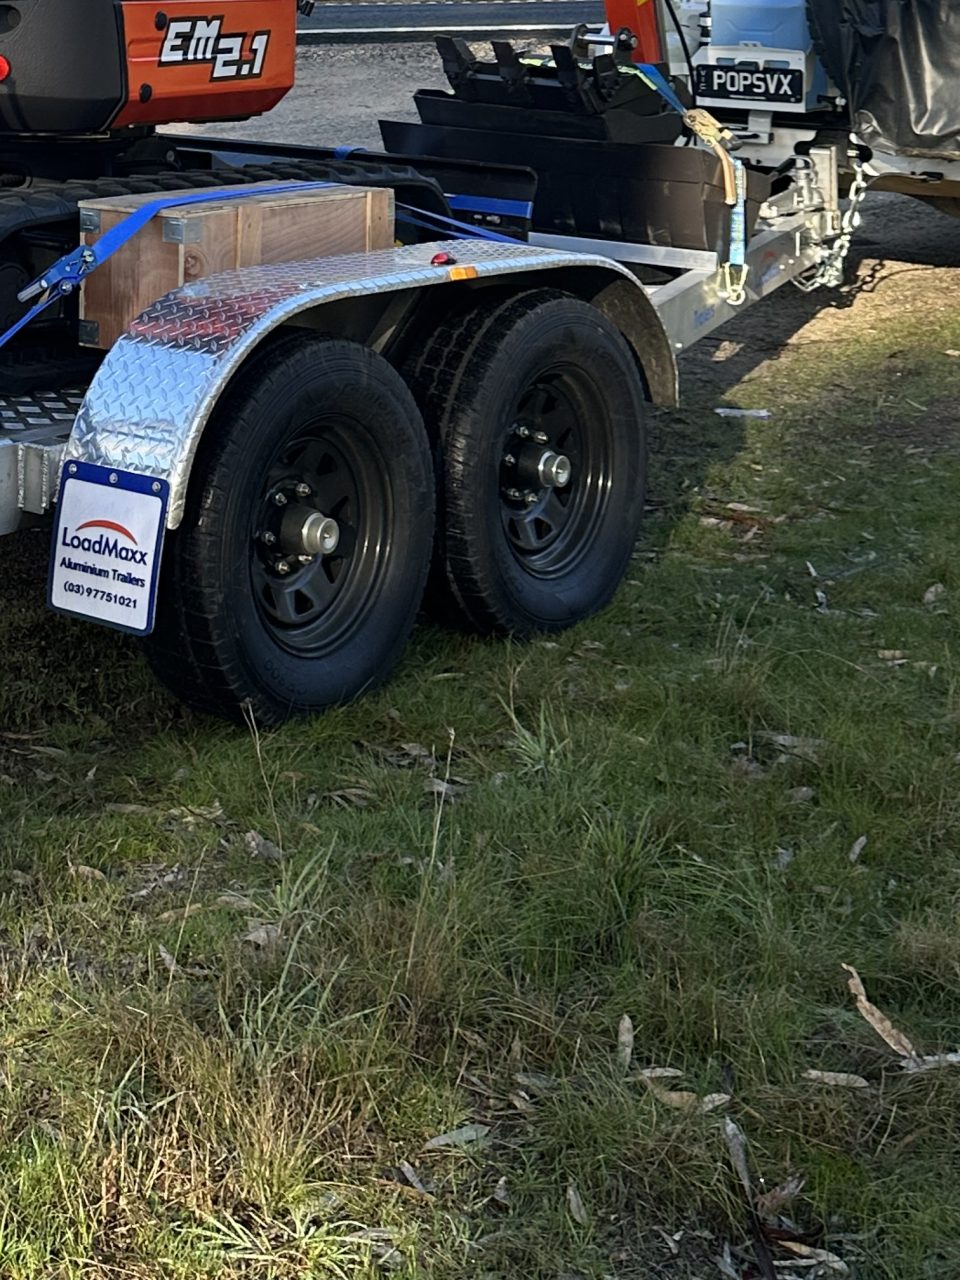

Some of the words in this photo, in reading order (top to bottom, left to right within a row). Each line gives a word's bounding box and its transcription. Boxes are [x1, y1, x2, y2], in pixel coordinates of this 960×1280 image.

[713, 70, 792, 95] POPSVX
[62, 527, 148, 566] LoadMaxx
[60, 557, 109, 579] Aluminium
[111, 568, 145, 588] Trailers
